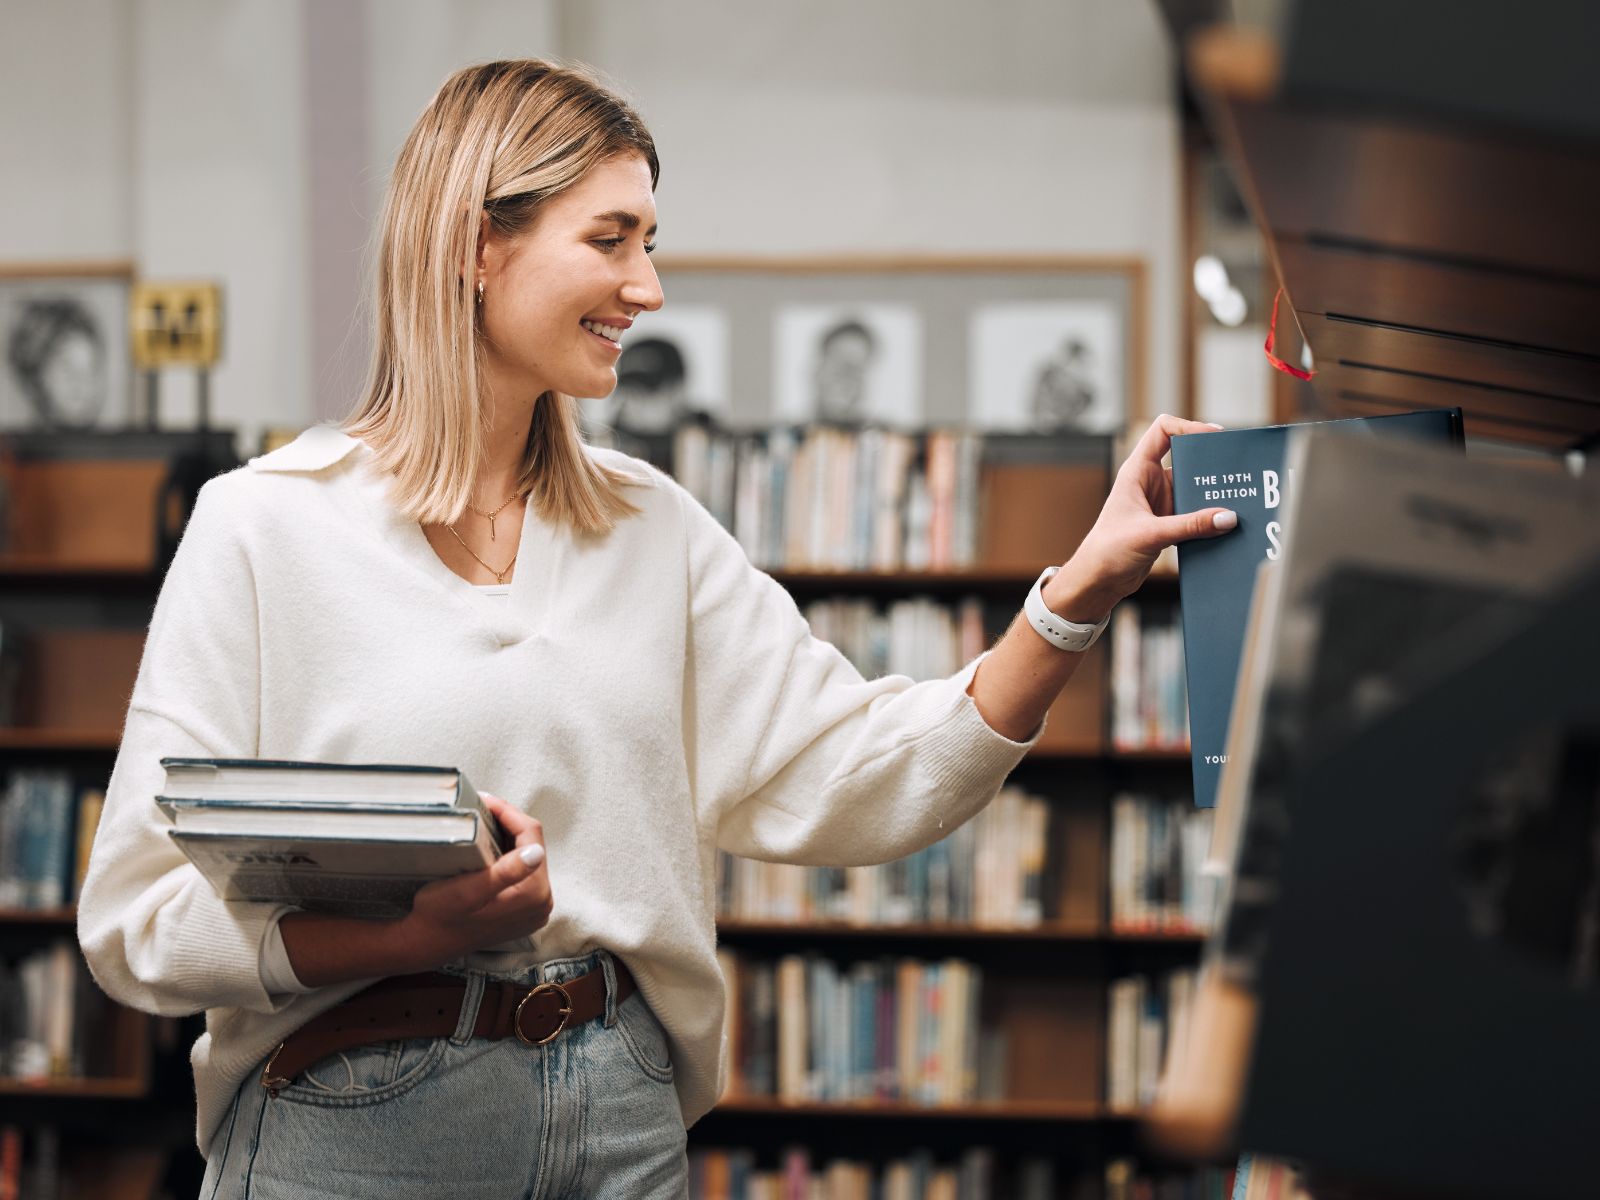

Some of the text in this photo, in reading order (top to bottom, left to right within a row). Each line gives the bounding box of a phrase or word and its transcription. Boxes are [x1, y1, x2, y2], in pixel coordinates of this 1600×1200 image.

[1193, 472, 1251, 486] THE 19TH
[1204, 487, 1257, 501] EDITION
